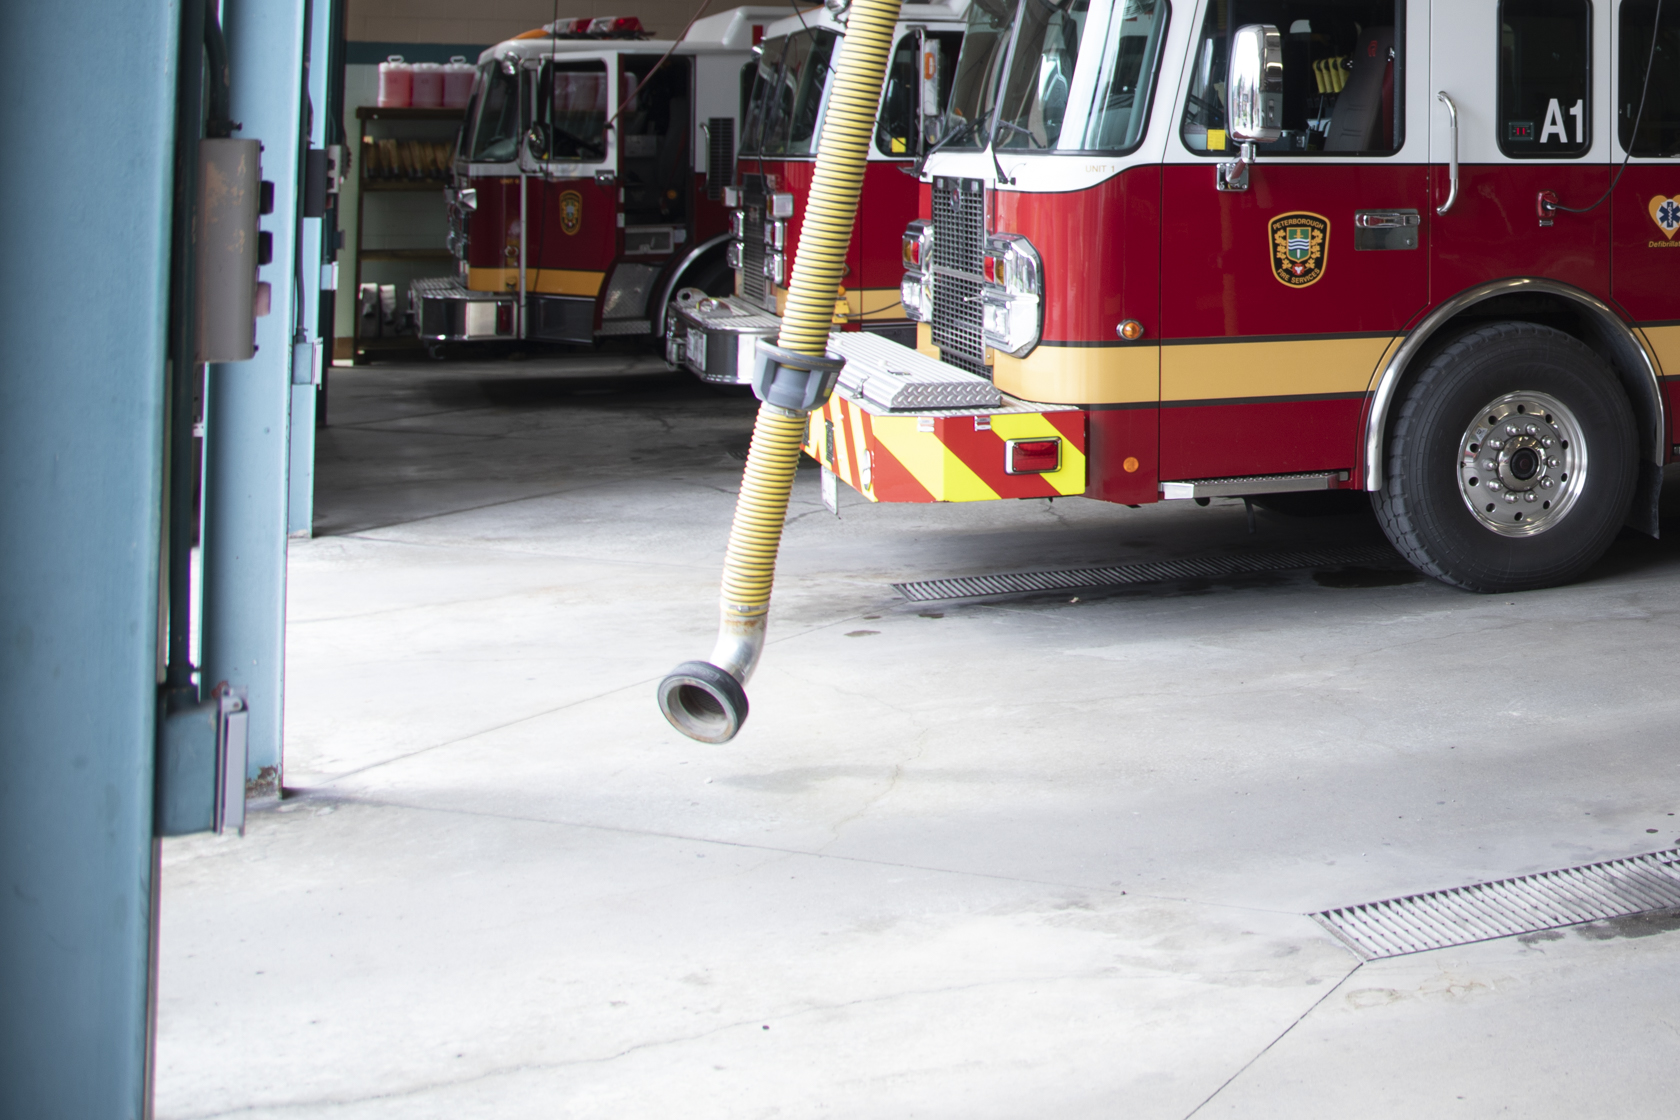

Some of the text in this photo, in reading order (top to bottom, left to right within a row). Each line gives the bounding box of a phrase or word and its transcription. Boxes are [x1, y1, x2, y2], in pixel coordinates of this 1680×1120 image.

[1539, 98, 1583, 143] A1
[1085, 165, 1115, 173] UNIT 1
[1272, 218, 1325, 231] PETERBOROUGH
[1276, 267, 1321, 284] FIRE SERVICES
